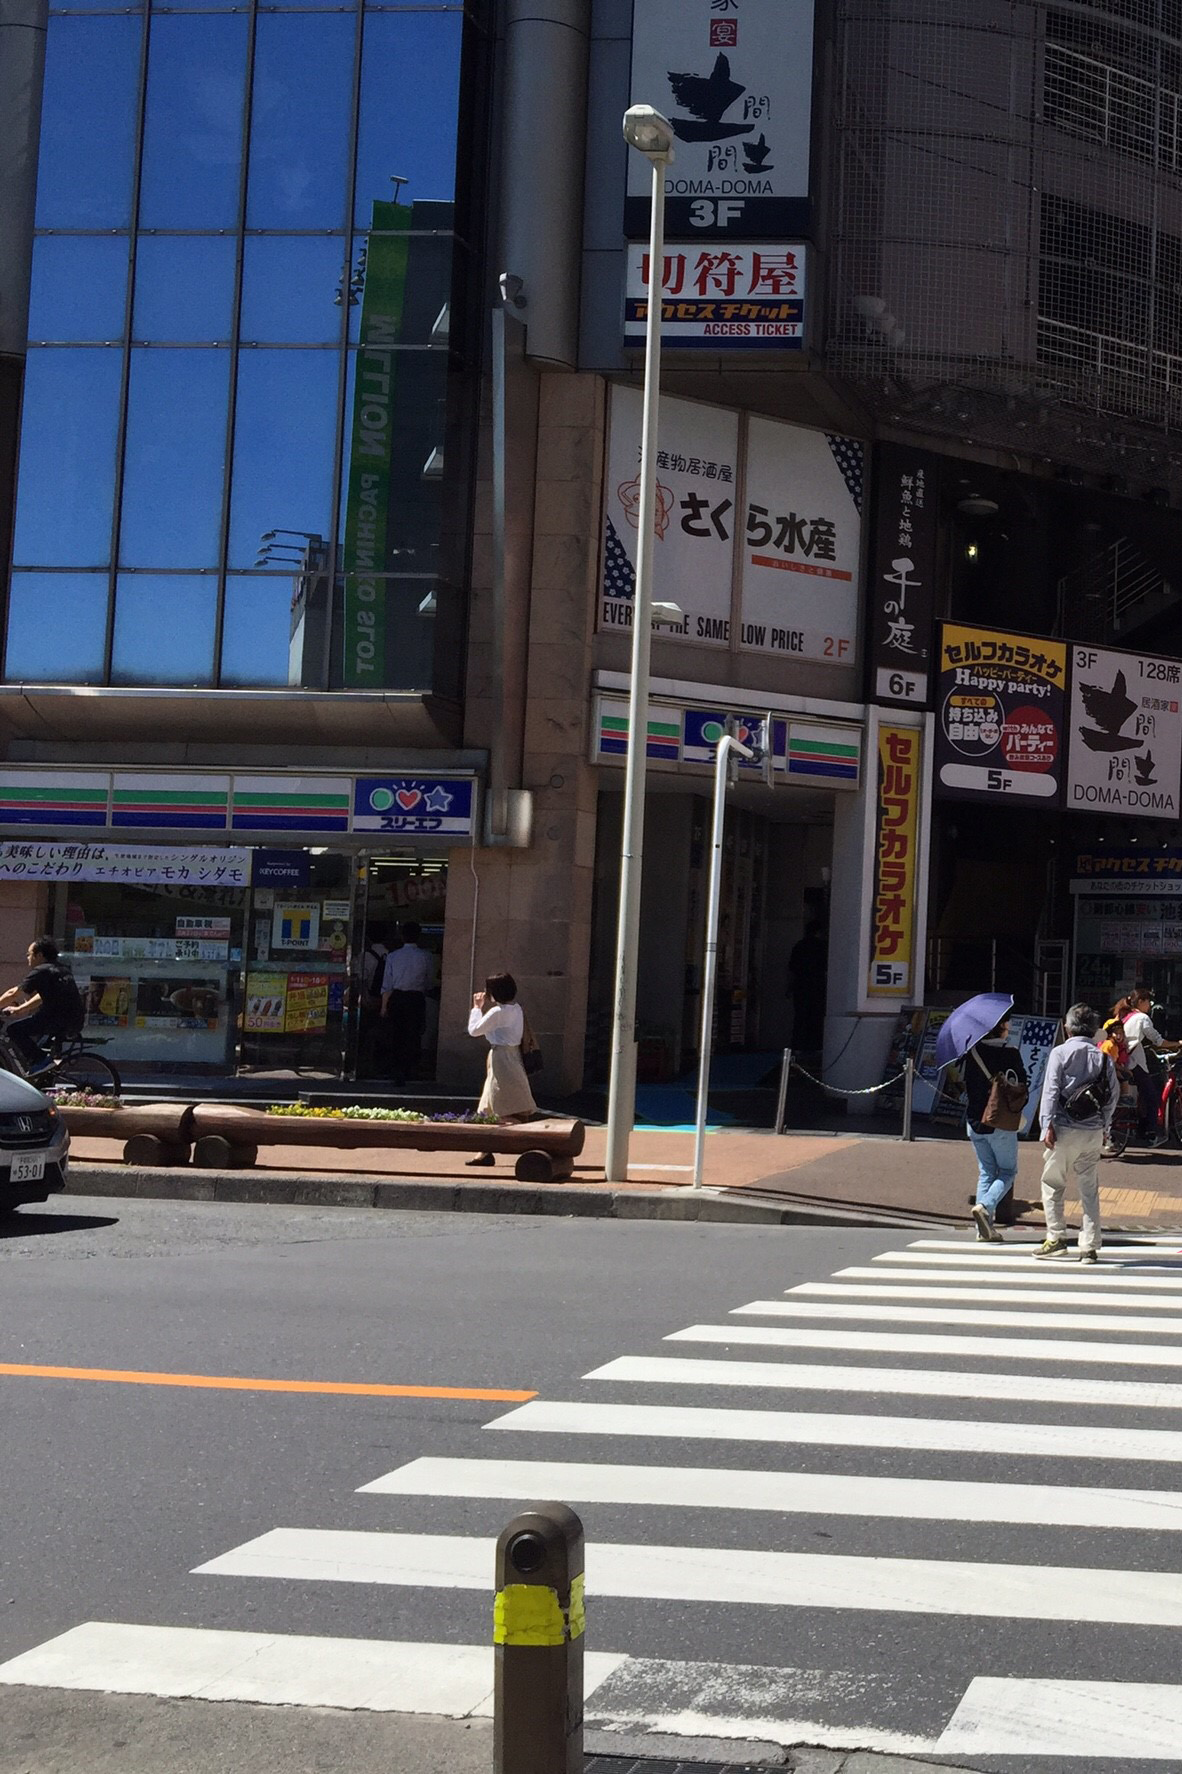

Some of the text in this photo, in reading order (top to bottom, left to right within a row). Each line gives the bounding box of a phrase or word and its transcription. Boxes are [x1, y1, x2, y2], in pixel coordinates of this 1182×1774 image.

[665, 180, 773, 195] DOMA-DOMA
[689, 200, 745, 227] 3F
[637, 251, 799, 297] 切符屋
[704, 323, 798, 336] ACCESS TICKET
[637, 445, 733, 483] 産物居酒屋
[680, 492, 837, 562] さくら水産
[882, 557, 922, 655] 千の庭
[697, 616, 729, 641] SAME
[741, 622, 767, 645] LOW
[771, 627, 804, 652] PRICE
[823, 637, 850, 657] 2F
[944, 641, 1063, 679] セルフカラオケ
[1076, 651, 1098, 669] 3F
[1138, 660, 1181, 684] 128席
[889, 674, 916, 697] 6F
[955, 668, 1052, 698] Happy party!
[949, 707, 999, 723] 持ち込み
[949, 723, 980, 741] 自由
[1021, 724, 1054, 734] みんなで
[1006, 735, 1054, 752] パーティー
[987, 770, 1012, 790] 5F
[1074, 784, 1174, 810] DOMA-DOMA
[381, 816, 443, 830] スリーエフ
[0, 844, 110, 861] 美味しい理由は、
[876, 732, 913, 956] セルフカラオケ
[95, 866, 156, 877] エチオピア
[161, 865, 190, 879] モカ
[199, 866, 243, 882] シダモ
[876, 964, 903, 985] 5F
